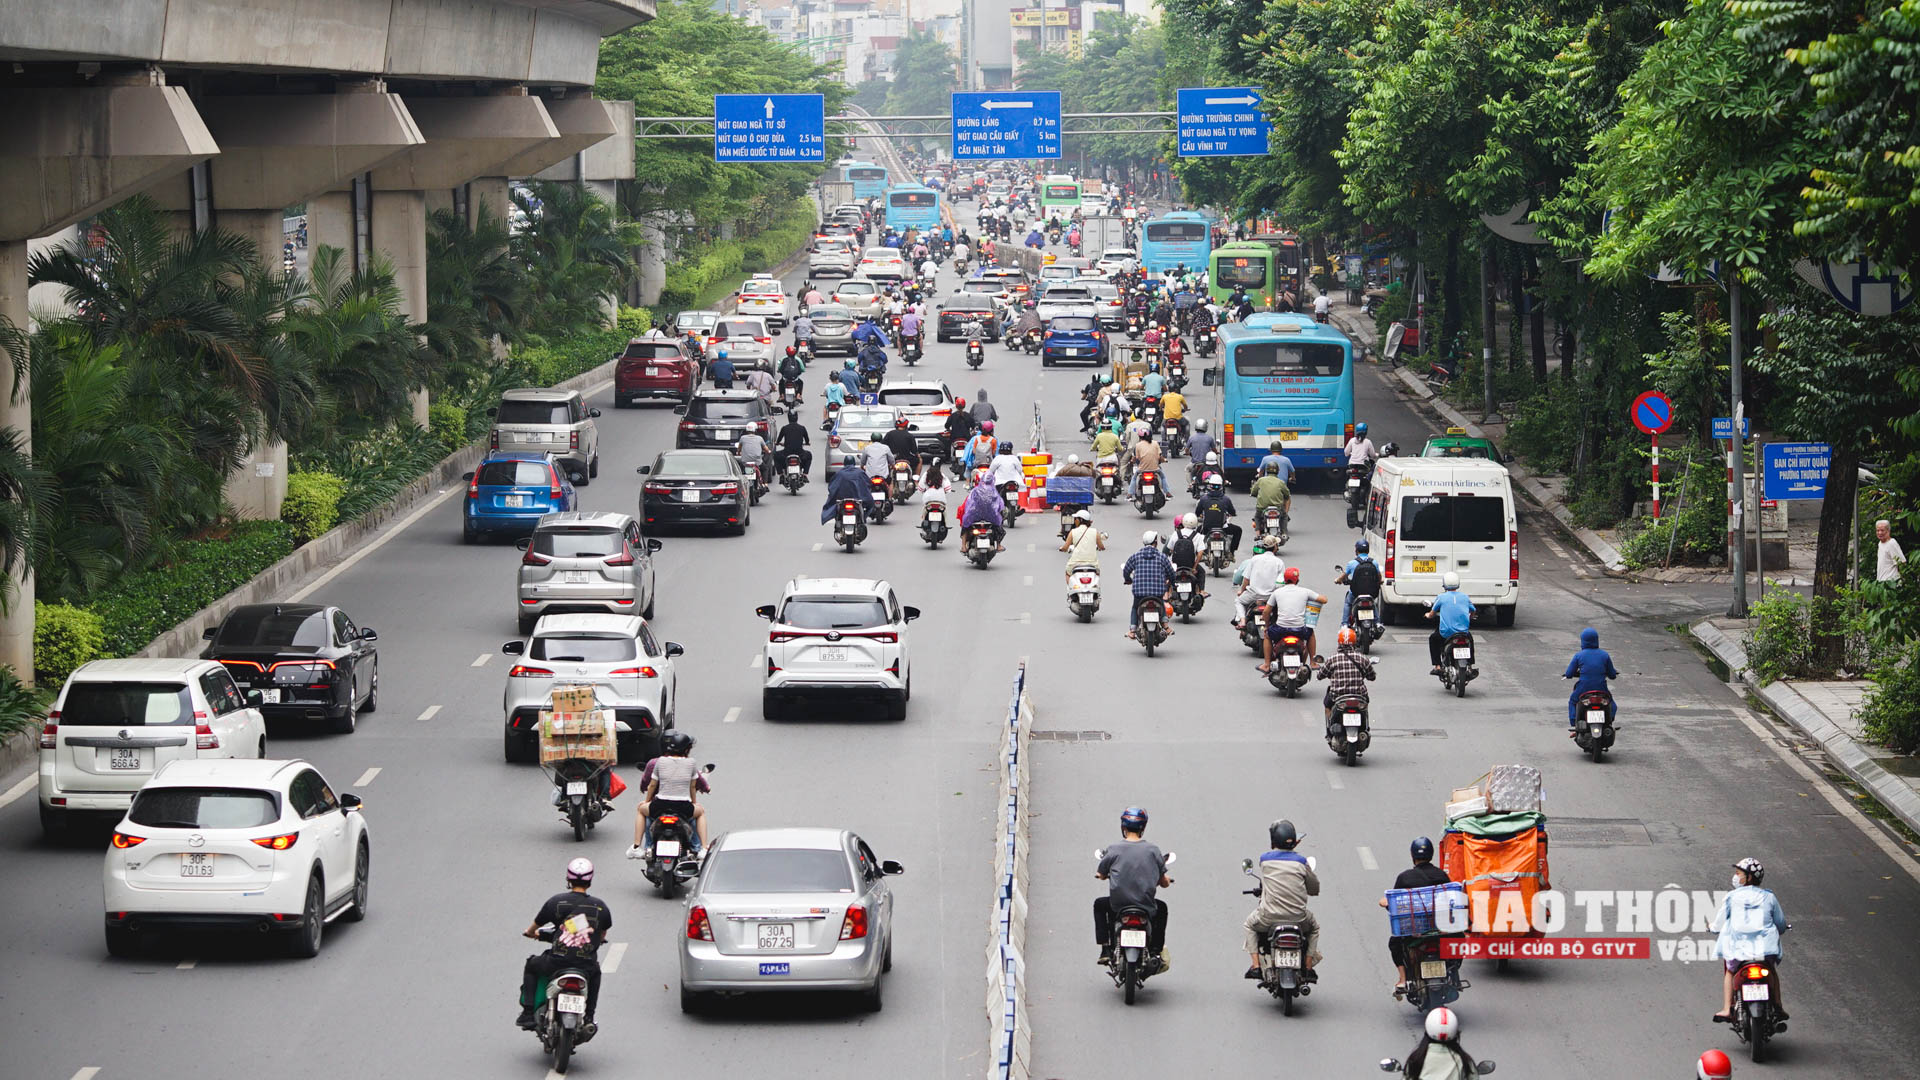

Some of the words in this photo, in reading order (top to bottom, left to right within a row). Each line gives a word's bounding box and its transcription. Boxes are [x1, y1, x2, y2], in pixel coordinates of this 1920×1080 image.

[958, 116, 979, 127] ĐƯỜNG
[982, 116, 999, 126] LÁNG
[1045, 118, 1055, 126] km
[1181, 113, 1203, 123] ĐƯỜNG
[1206, 112, 1232, 122] TRƯỜNG
[1234, 114, 1254, 122] CHINH
[718, 119, 730, 129] NÚT
[732, 121, 747, 129] GIAO
[750, 119, 762, 129] NGÃ
[766, 120, 774, 129] TƯ
[777, 118, 786, 129] SỞ
[958, 130, 970, 140] NÚT
[972, 132, 987, 140] GIAO
[990, 130, 1001, 140] CẦU
[1005, 130, 1019, 140] GIẤY
[1039, 132, 1043, 140] 5
[1045, 132, 1056, 140] km
[1182, 127, 1194, 137] NÚT
[1213, 127, 1226, 136] NGÃ
[1228, 128, 1237, 136] TƯ
[1239, 128, 1256, 137] VỌNG
[718, 132, 730, 142] NÚT
[733, 134, 747, 142] GIAO
[756, 134, 769, 144] CHỢ
[800, 134, 809, 143] 2,5
[811, 134, 822, 142] km
[958, 144, 970, 154] CẦU
[973, 144, 989, 155] NHẬT
[993, 144, 1005, 154] TÂN
[1037, 145, 1043, 153] 11
[1045, 145, 1056, 153] km
[1182, 140, 1195, 151] CẦU
[1197, 141, 1213, 150] VĨNH
[1216, 142, 1227, 150] TUY
[719, 146, 731, 156] VĂN
[733, 146, 748, 156] MIẾU
[750, 146, 767, 156] QUỐC
[769, 146, 777, 156] TỬ
[779, 146, 795, 156] GIÁM
[800, 148, 810, 156] 4,3
[811, 148, 821, 156] km
[1774, 459, 1786, 468] BAN
[1799, 458, 1810, 468] HUY
[118, 750, 133, 758] 30A
[112, 759, 139, 768] 566.43
[189, 855, 206, 864] 30F
[183, 866, 213, 875] 701.63
[767, 926, 784, 936] 30A
[760, 938, 792, 948] 067.25
